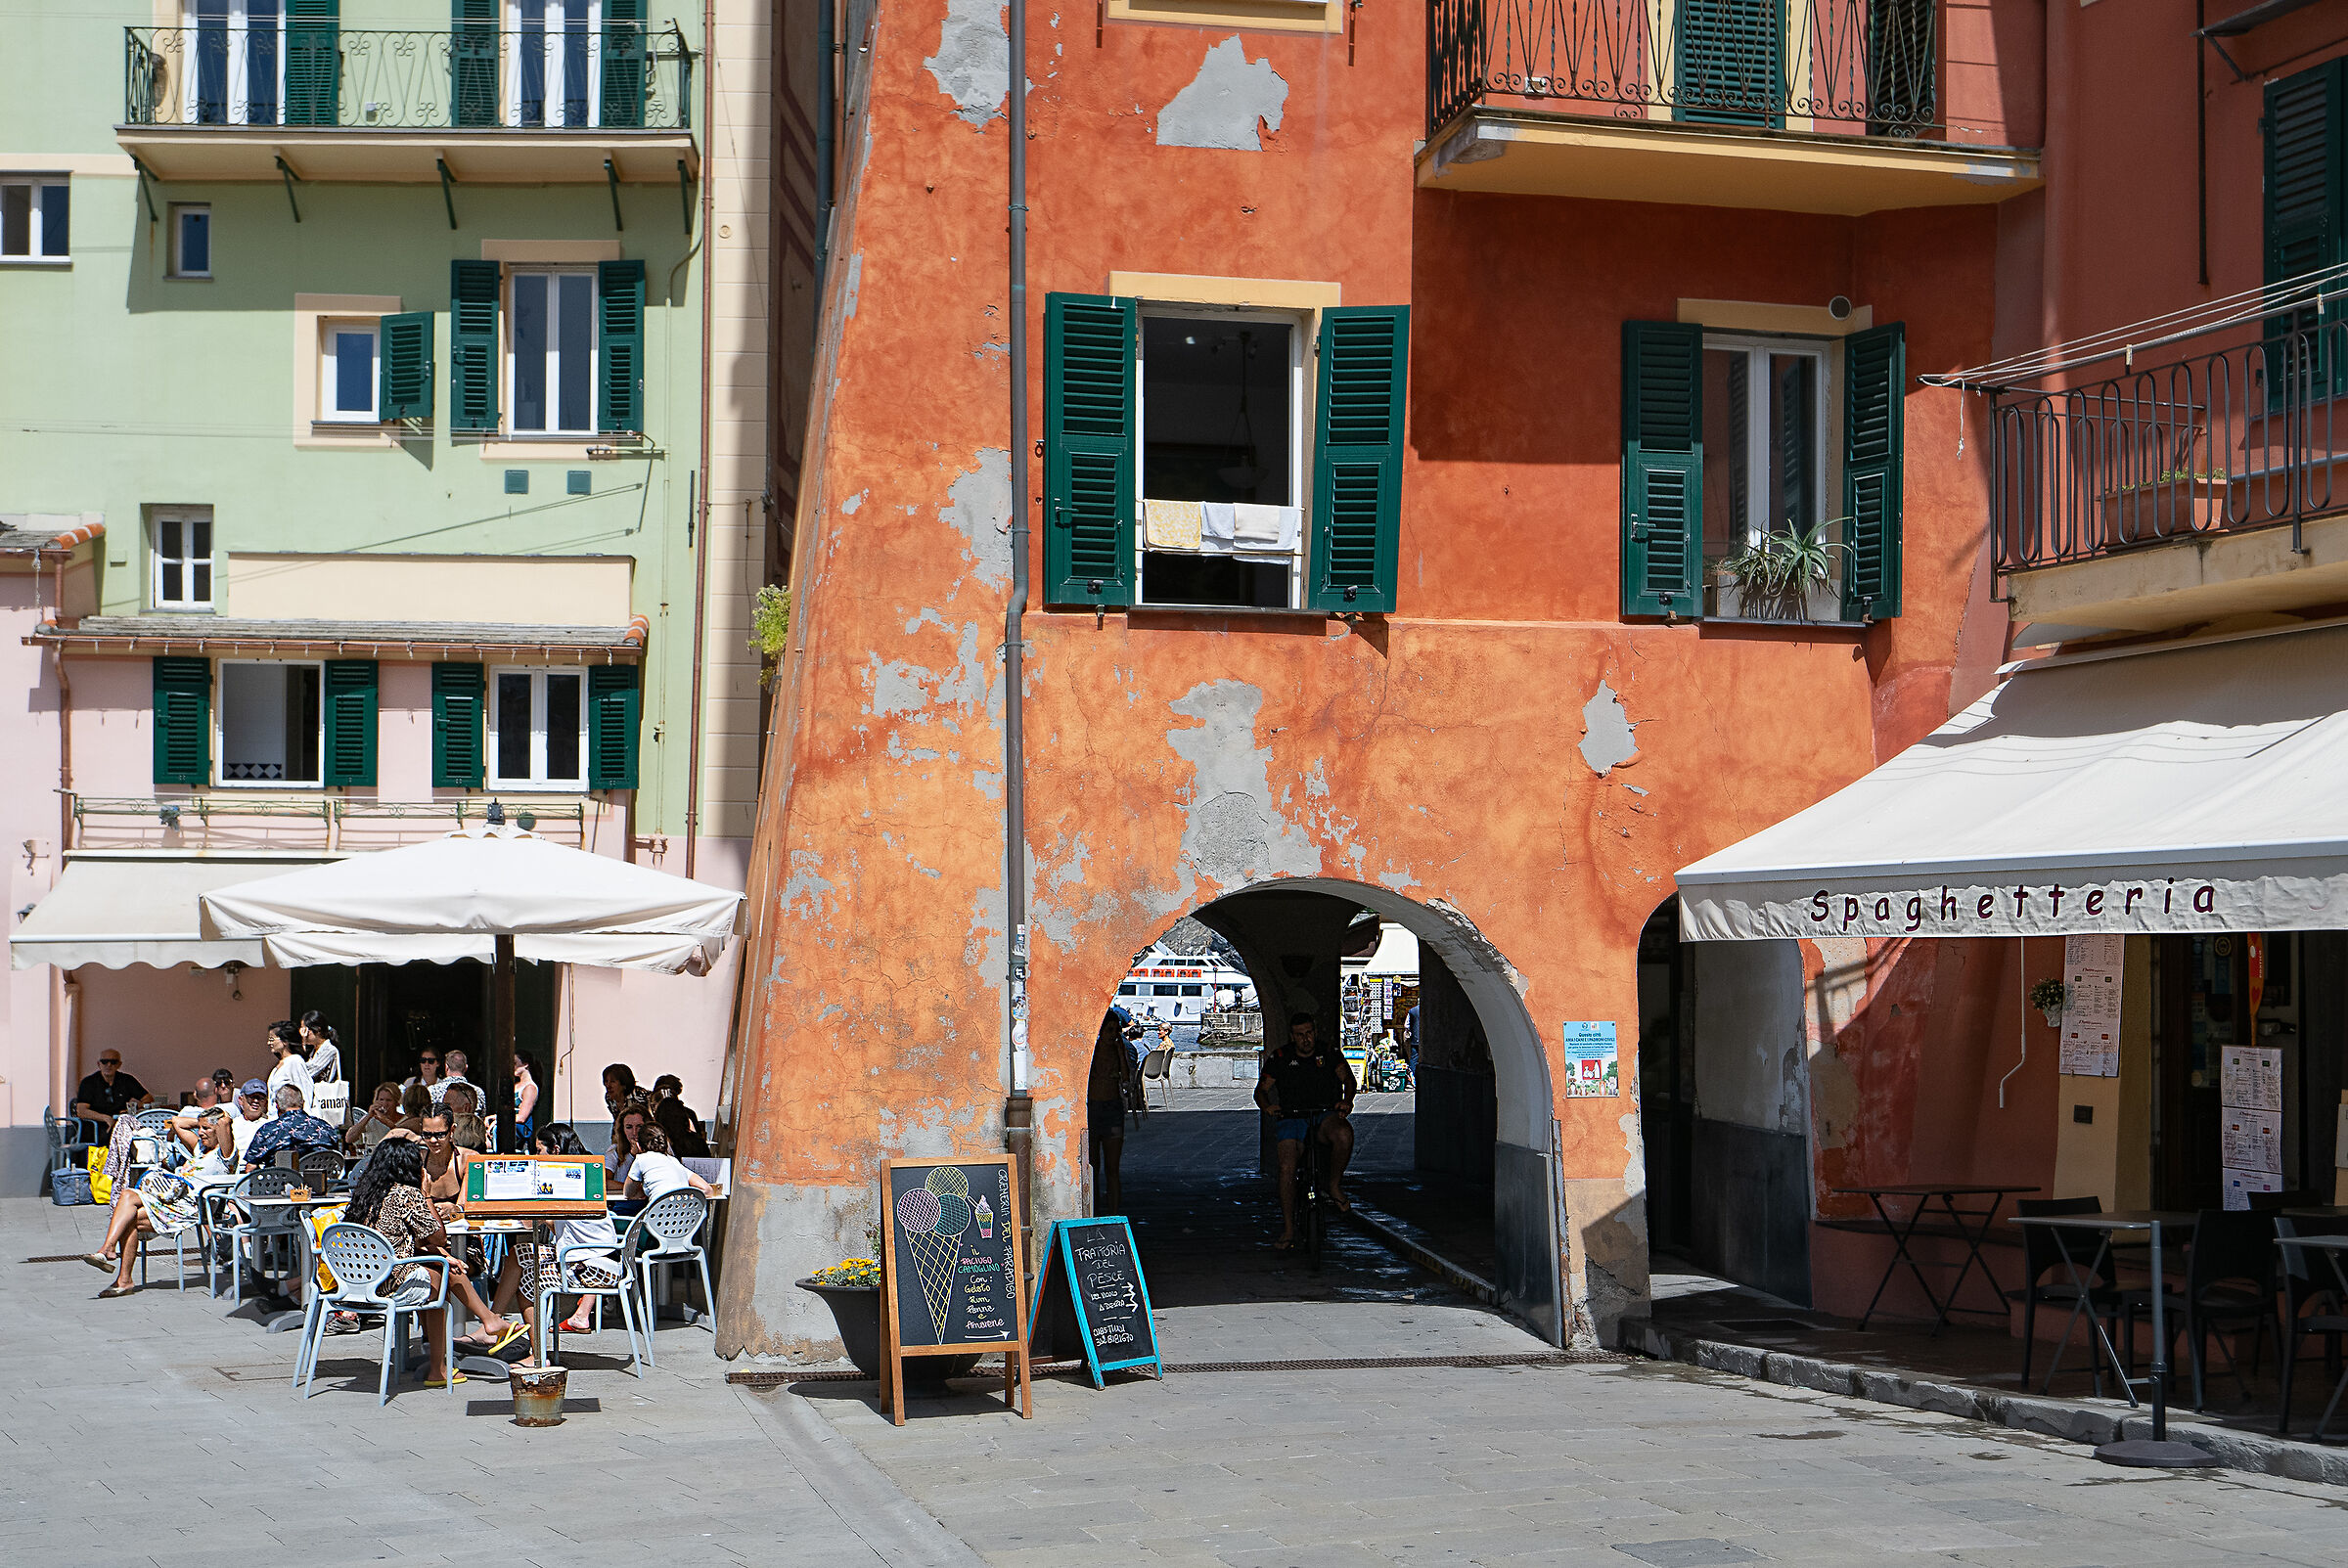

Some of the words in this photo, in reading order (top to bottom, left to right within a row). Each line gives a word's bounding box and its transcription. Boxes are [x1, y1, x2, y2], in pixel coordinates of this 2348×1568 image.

[1810, 876, 2215, 931] Spaghetteria
[998, 1168, 1011, 1217] CREMERIA
[1001, 1220, 1012, 1243] DEL
[961, 1256, 993, 1265] PACIUGO
[1091, 1259, 1115, 1269] DEL
[1003, 1244, 1016, 1300] PARADISO
[1087, 1271, 1125, 1288] PESCE
[964, 1283, 991, 1293] Gelato
